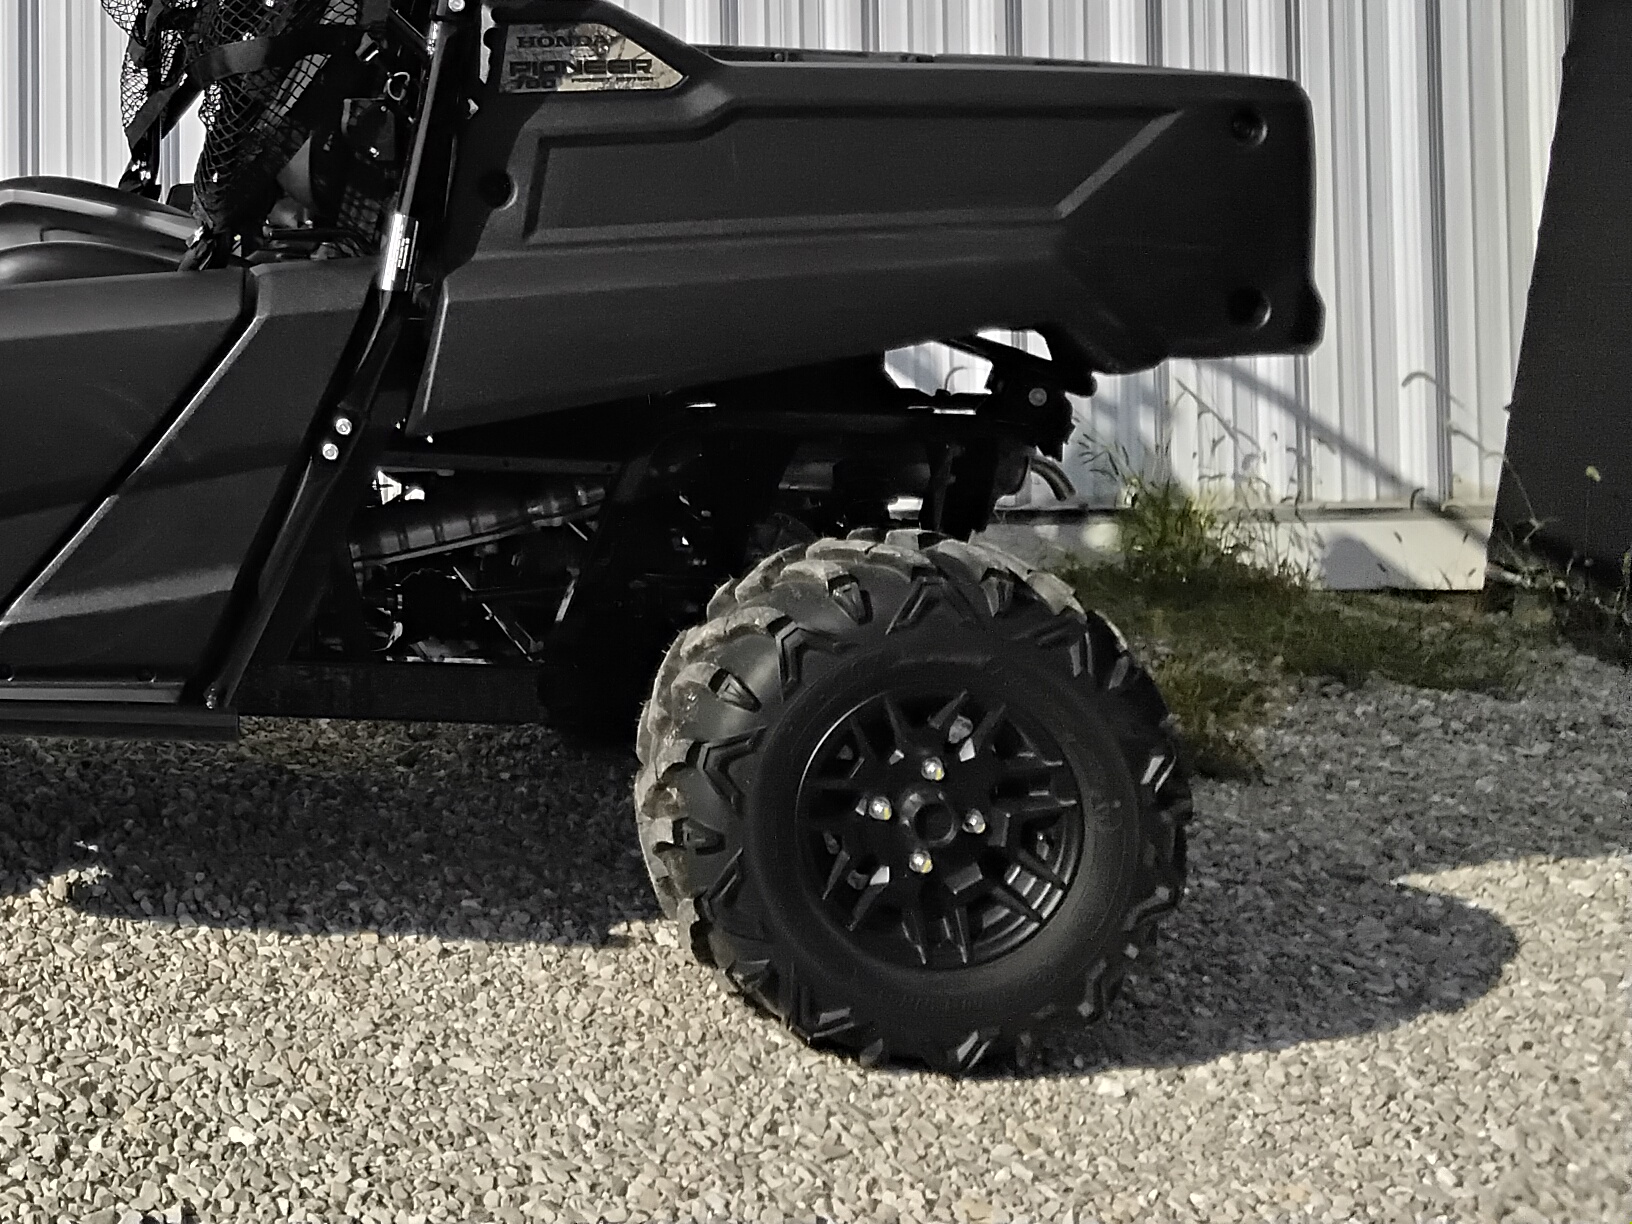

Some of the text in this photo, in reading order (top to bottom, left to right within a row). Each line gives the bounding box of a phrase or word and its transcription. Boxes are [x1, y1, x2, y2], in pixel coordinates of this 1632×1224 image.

[516, 35, 610, 48] HONDA
[509, 59, 653, 75] PIONEER
[511, 76, 557, 89] 700
